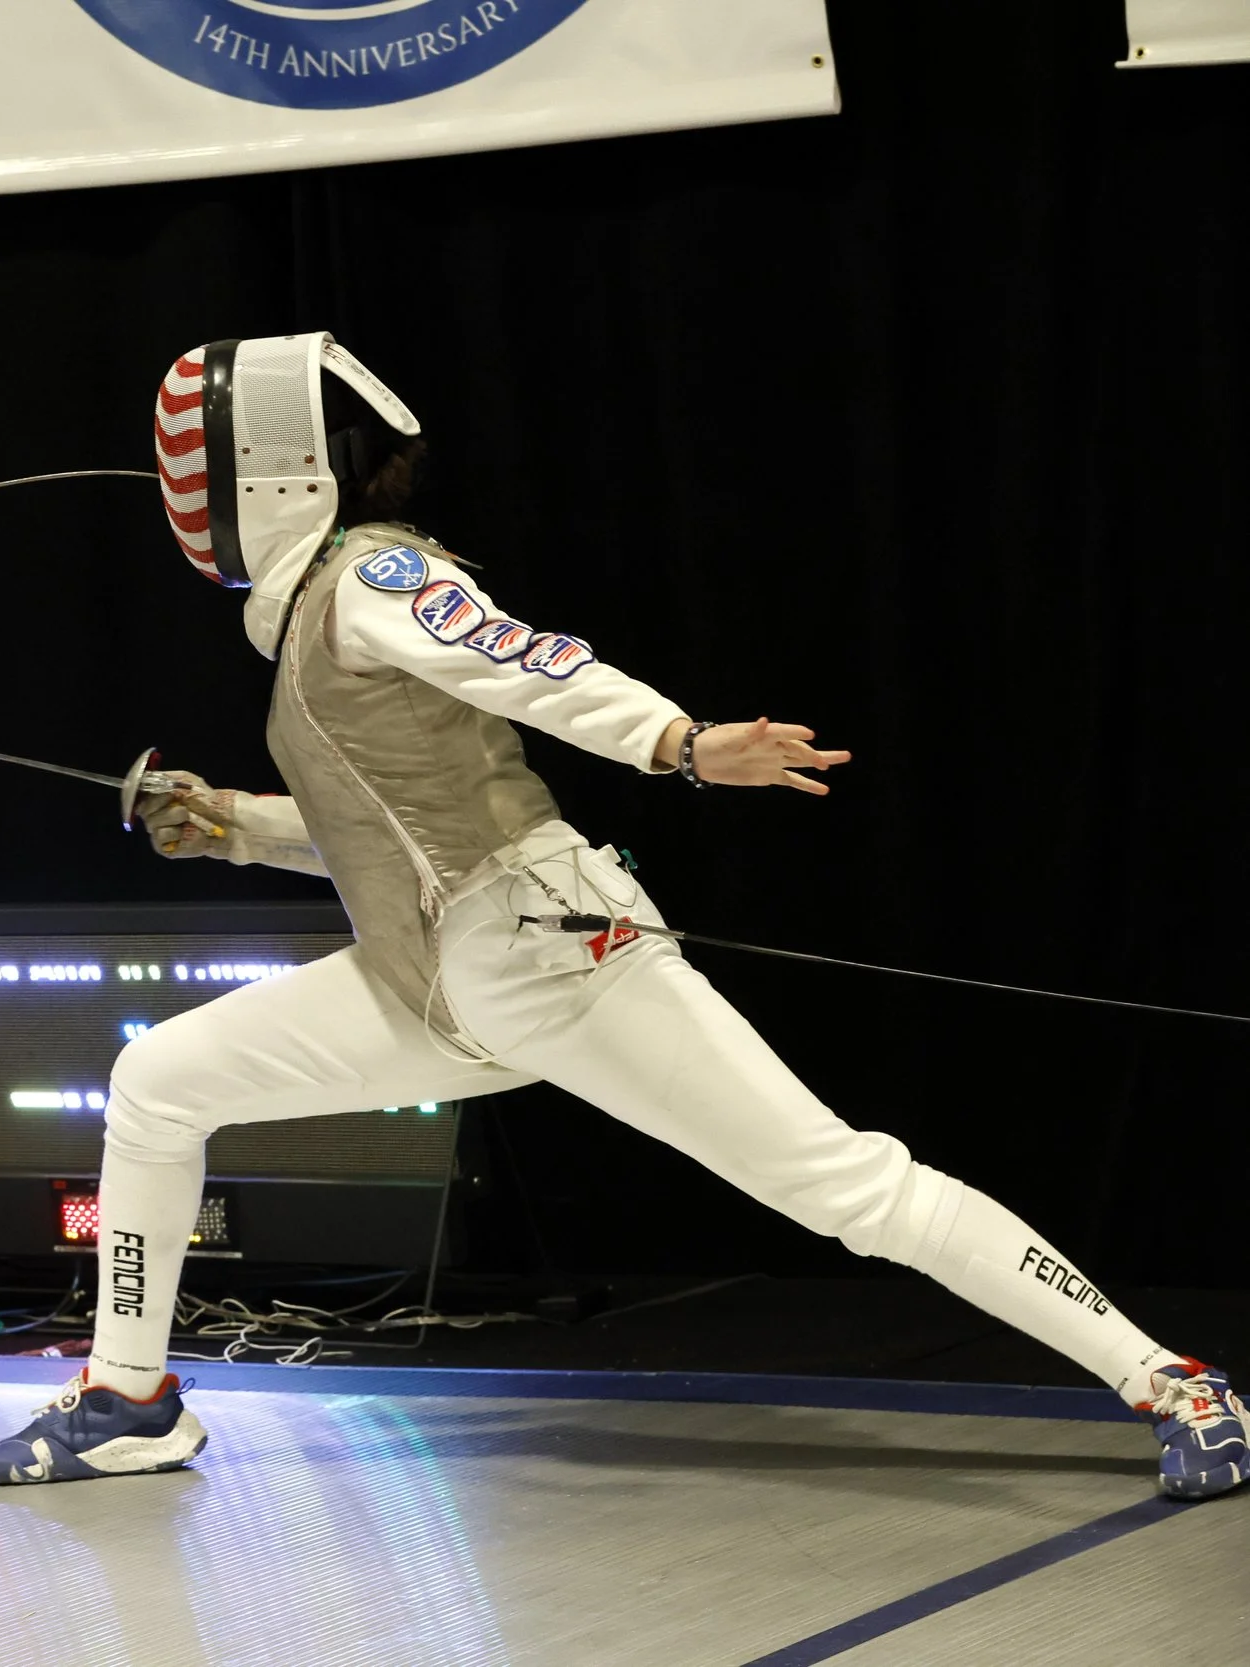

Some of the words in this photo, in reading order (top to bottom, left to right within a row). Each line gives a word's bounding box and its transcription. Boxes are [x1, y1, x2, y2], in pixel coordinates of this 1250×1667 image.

[194, 15, 270, 70] 14TH
[113, 1230, 145, 1318] FENCING
[1019, 1246, 1112, 1316] FENCING
